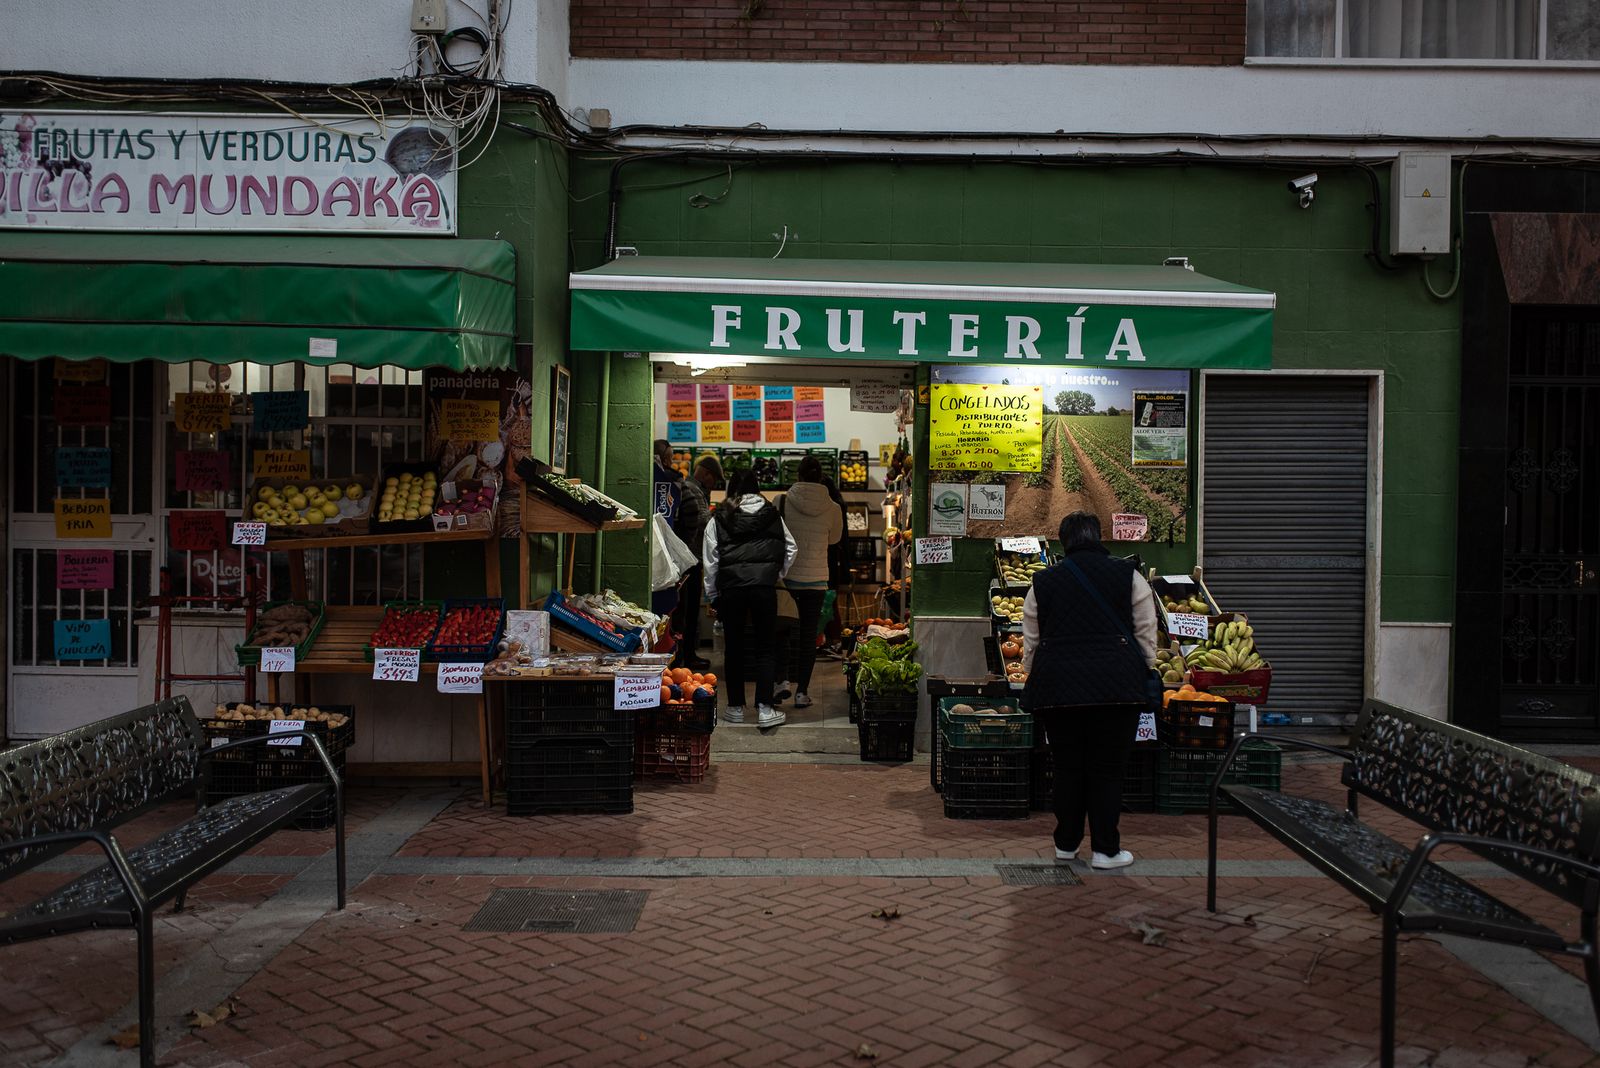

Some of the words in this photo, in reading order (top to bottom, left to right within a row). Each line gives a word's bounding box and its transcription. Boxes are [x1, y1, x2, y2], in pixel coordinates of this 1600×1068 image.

[34, 128, 154, 160] FRUTAS
[166, 129, 185, 160] Y
[199, 130, 377, 163] VERDURAS
[148, 173, 441, 218] MUNDAKA
[709, 303, 1146, 361] FRUTERÍA
[940, 395, 1030, 411] CONGELADOS
[955, 413, 1028, 422] DISTRIBUCIONES
[657, 484, 668, 516] Casado
[62, 503, 105, 514] BEBIDA
[64, 520, 95, 530] FRIA
[65, 624, 92, 633] VINO
[443, 675, 480, 685] ASADO
[618, 684, 661, 694] MEMBRILLO
[619, 697, 655, 707] MOGUER
